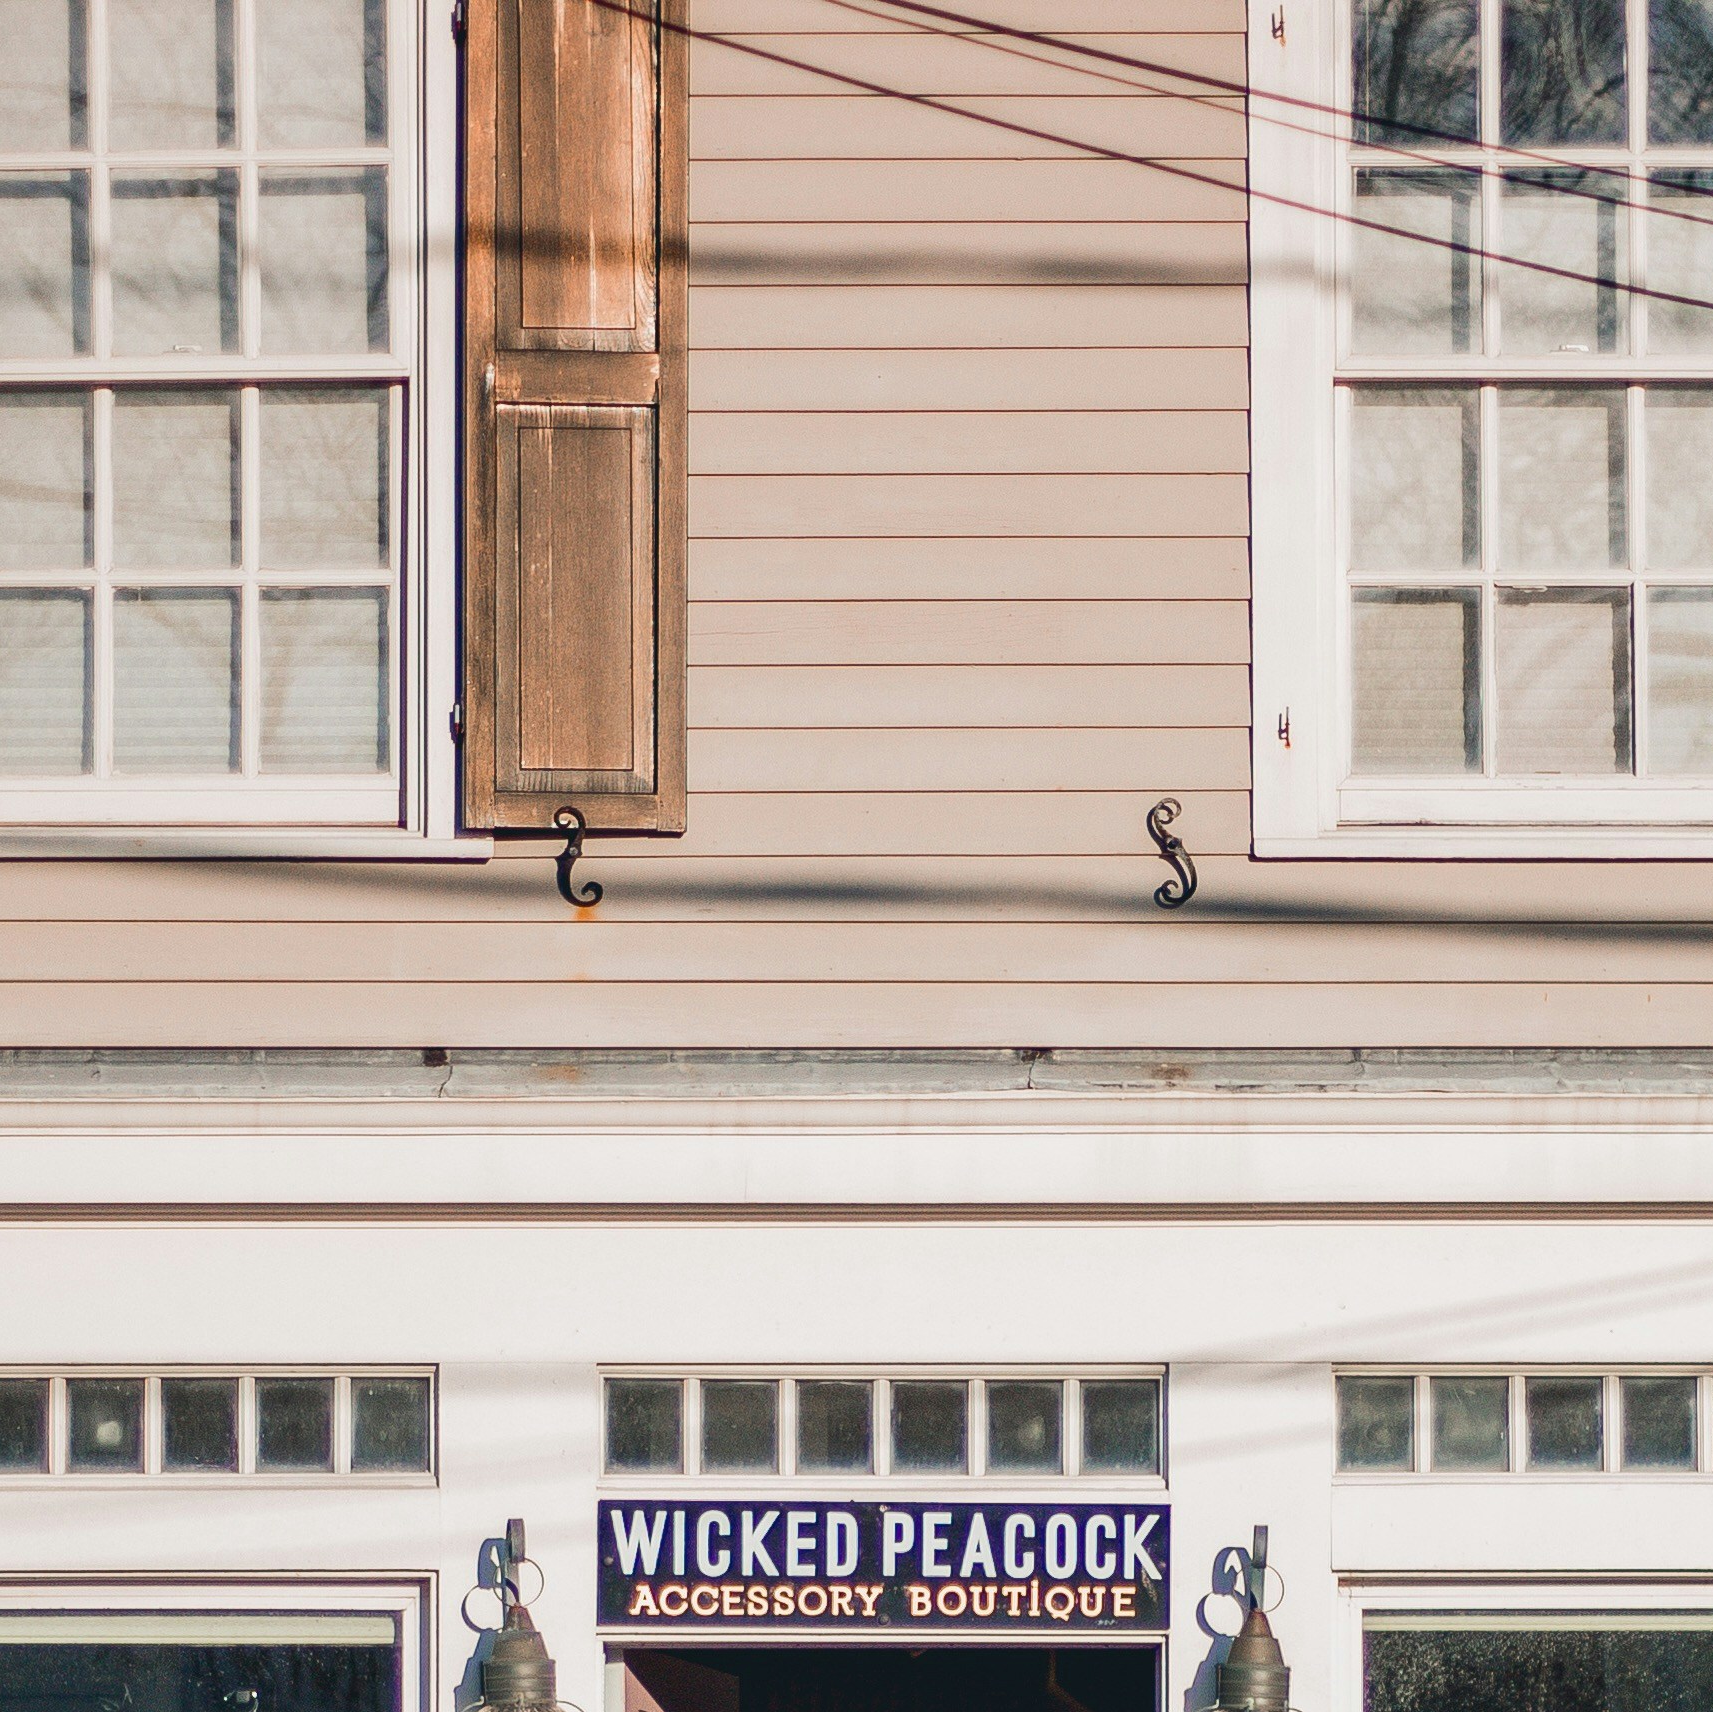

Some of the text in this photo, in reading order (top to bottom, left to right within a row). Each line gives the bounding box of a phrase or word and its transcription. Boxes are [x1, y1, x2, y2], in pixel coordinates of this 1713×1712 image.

[610, 1509, 1164, 1581] WICKED PEACOCK
[629, 1584, 884, 1617] ACCESSORY
